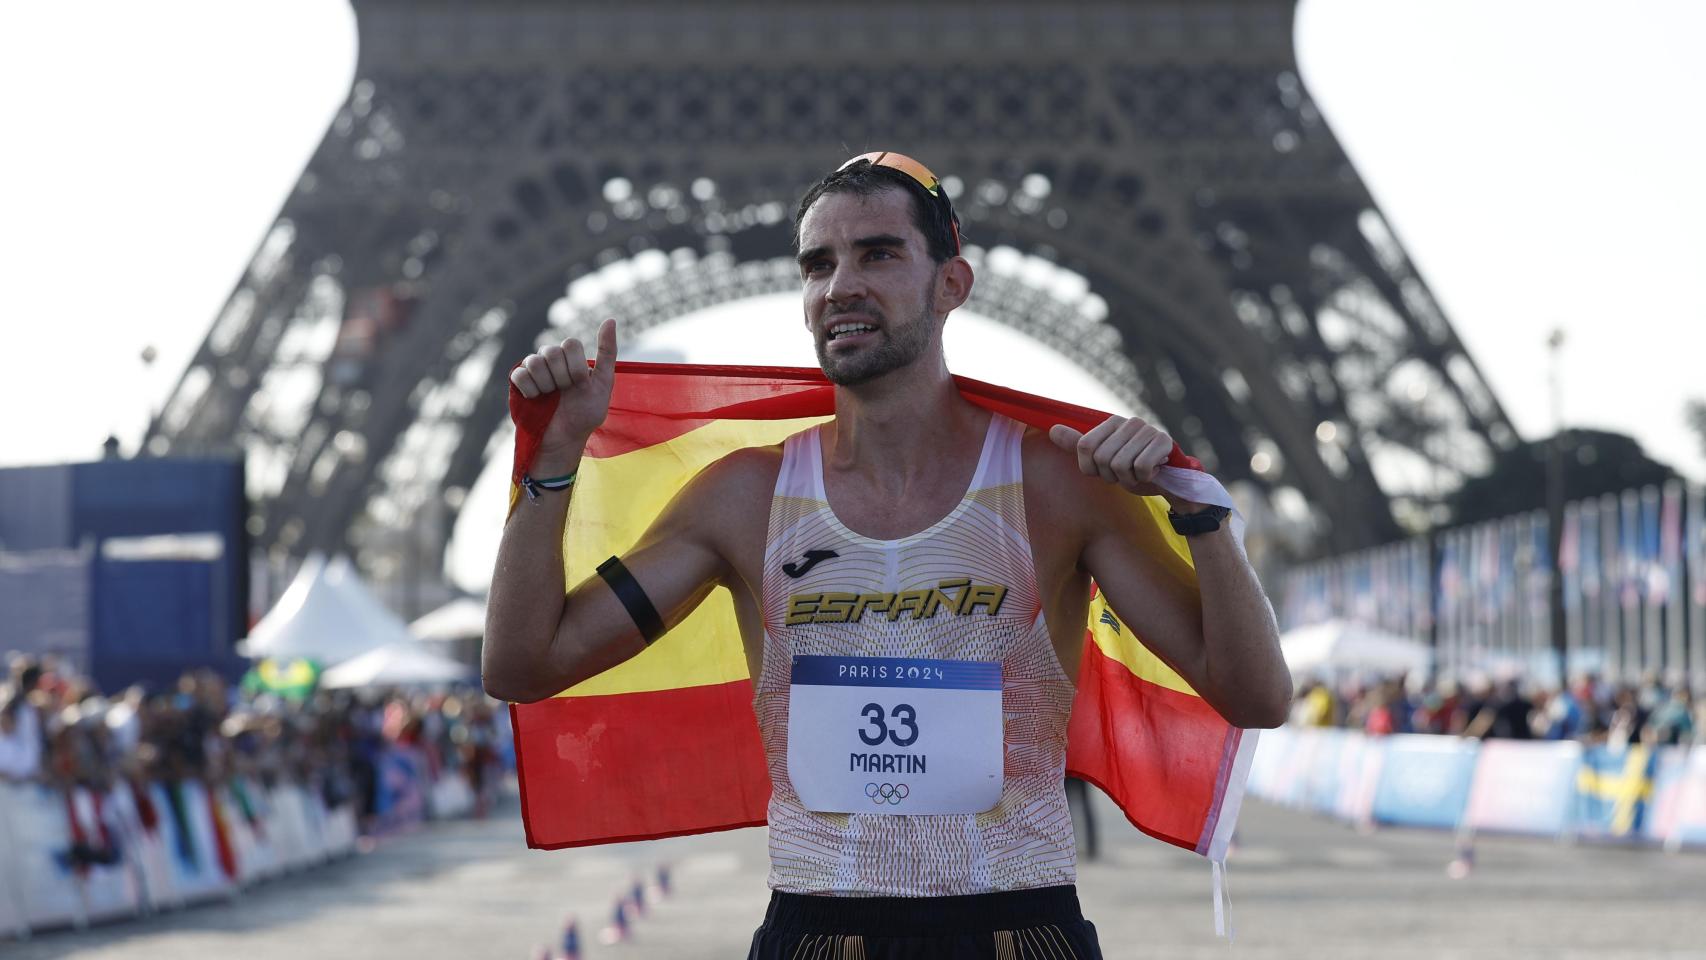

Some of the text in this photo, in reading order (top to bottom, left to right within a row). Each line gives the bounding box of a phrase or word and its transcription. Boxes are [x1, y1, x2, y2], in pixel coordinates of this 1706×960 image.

[785, 577, 1008, 626] ESPAÑA
[895, 666, 943, 680] 2024
[858, 702, 919, 747] 33
[850, 752, 926, 774] MARTIN
